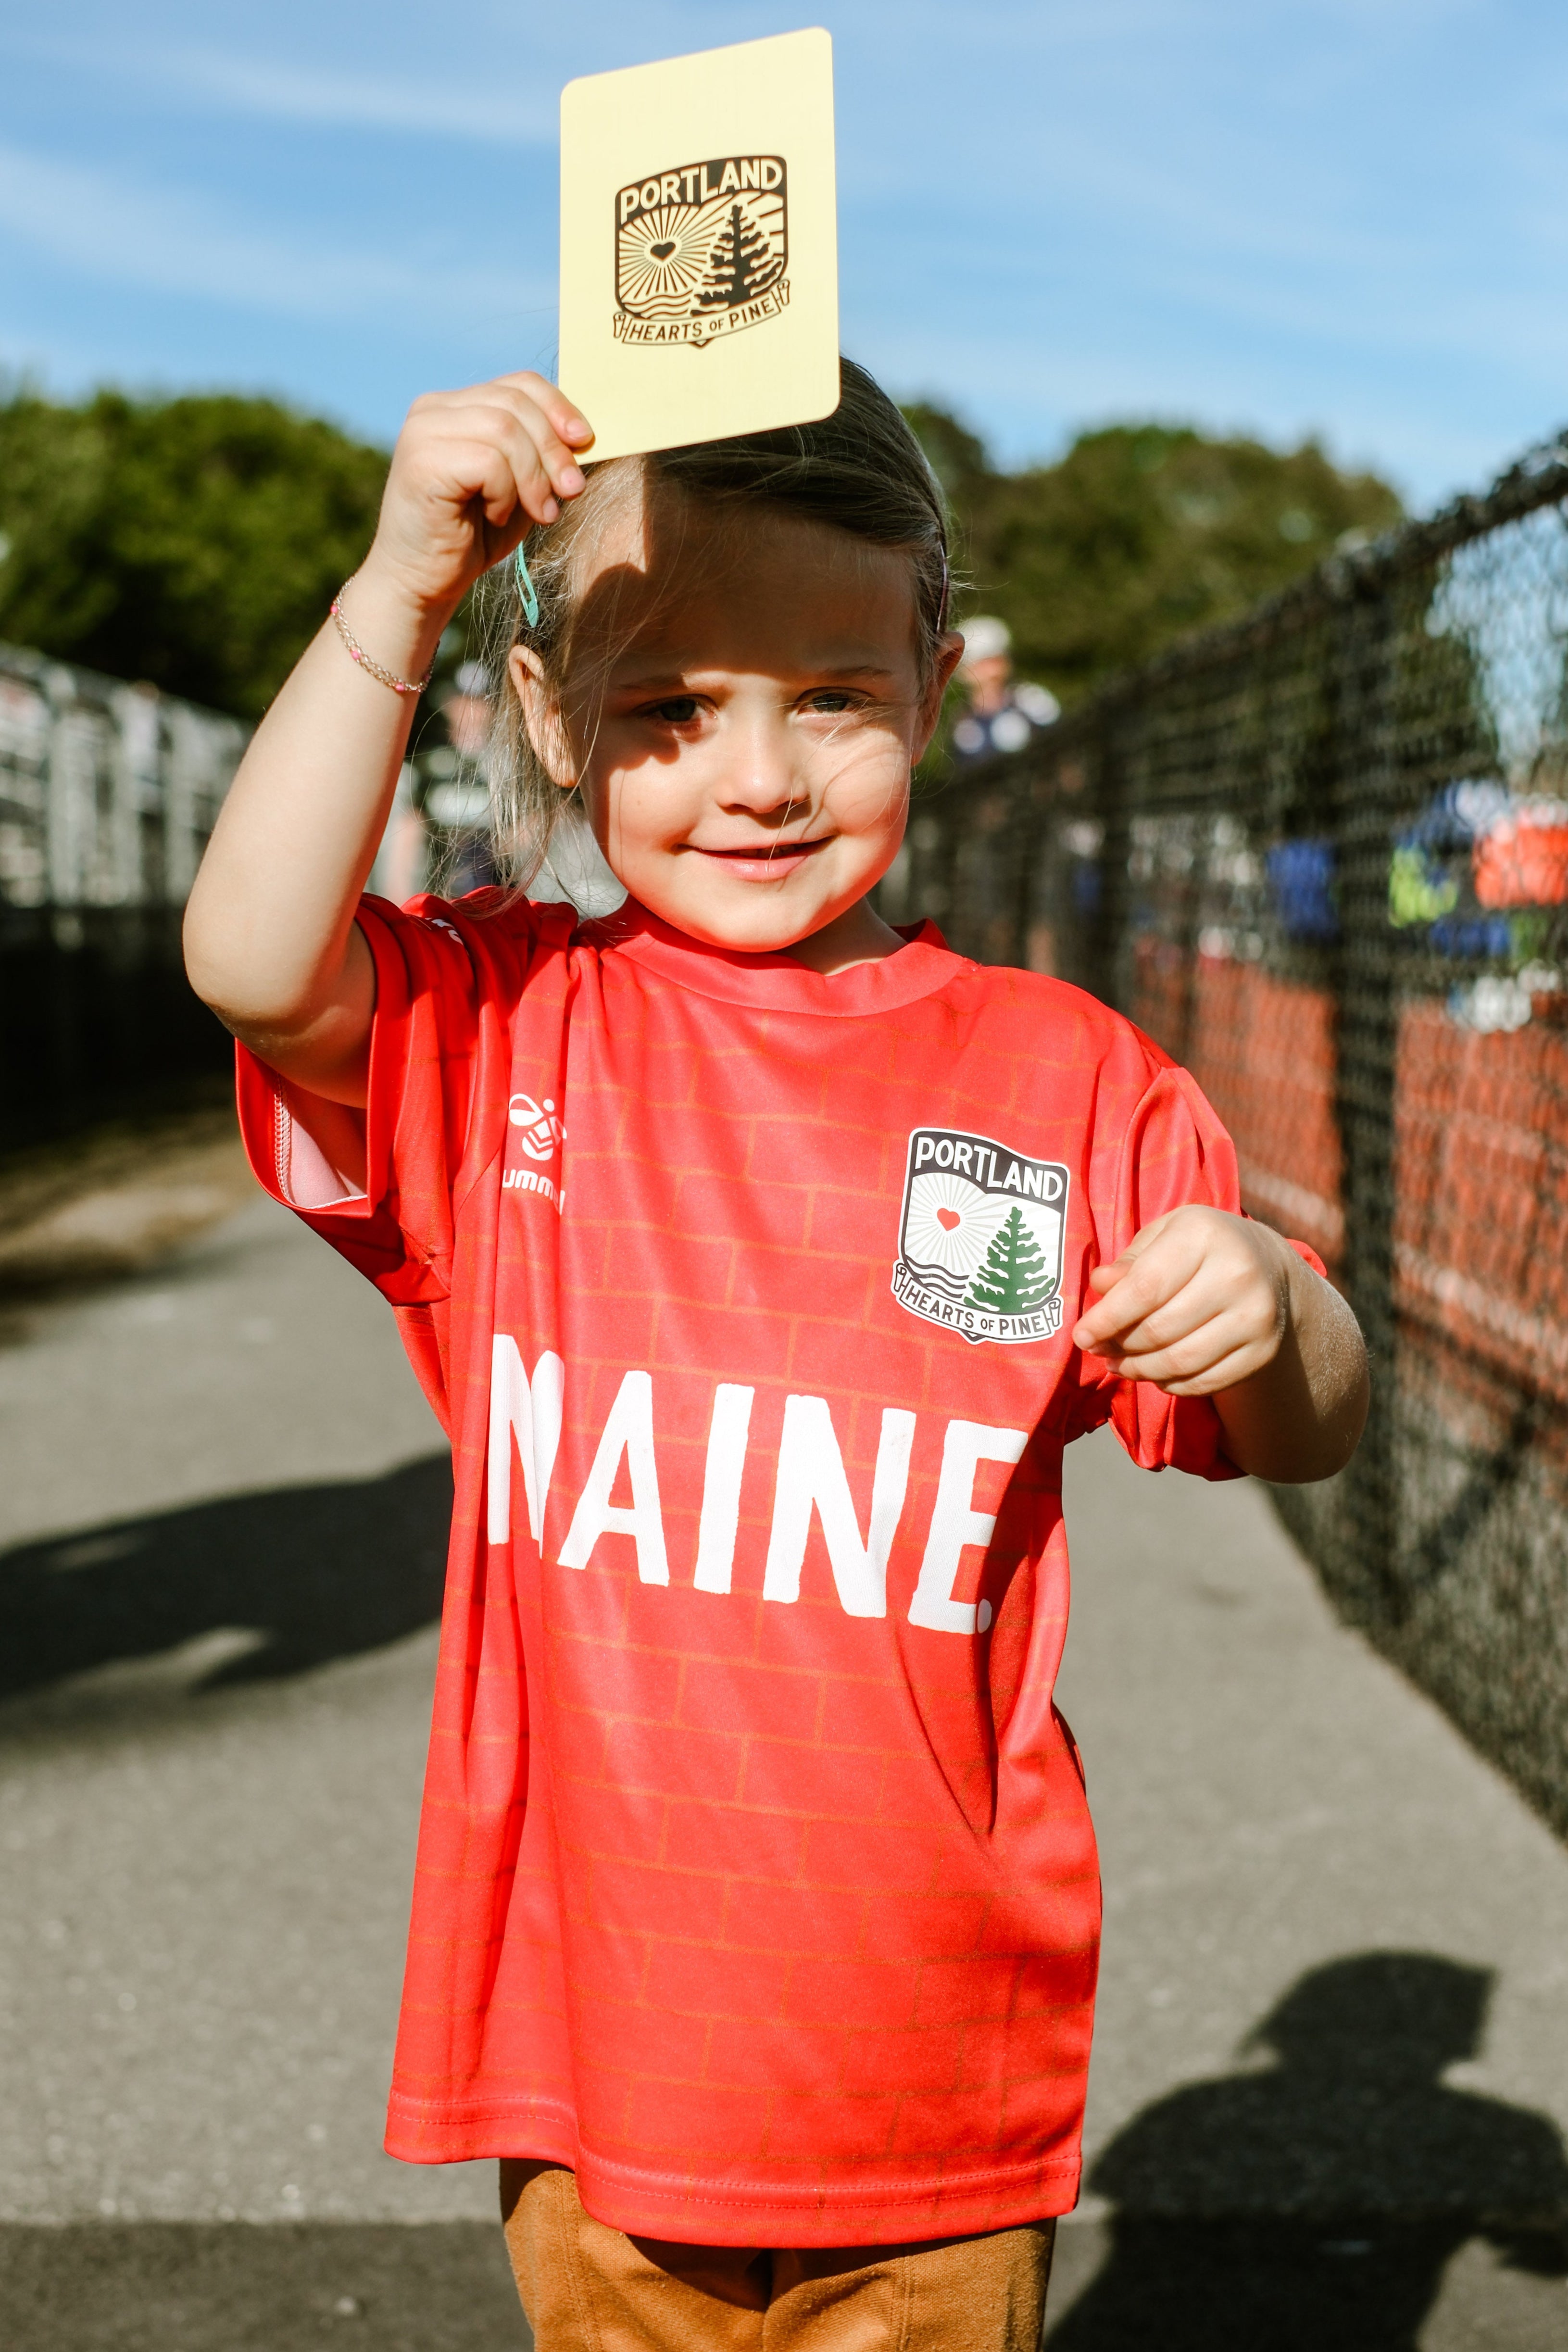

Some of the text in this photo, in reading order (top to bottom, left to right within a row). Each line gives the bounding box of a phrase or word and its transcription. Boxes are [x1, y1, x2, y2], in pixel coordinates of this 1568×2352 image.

[621, 158, 783, 225] PORTLAND
[628, 297, 775, 341] HEARTS OF PINE
[915, 1137, 1063, 1202] PORTLAND
[905, 1284, 1045, 1335] HEARTS OF PINE
